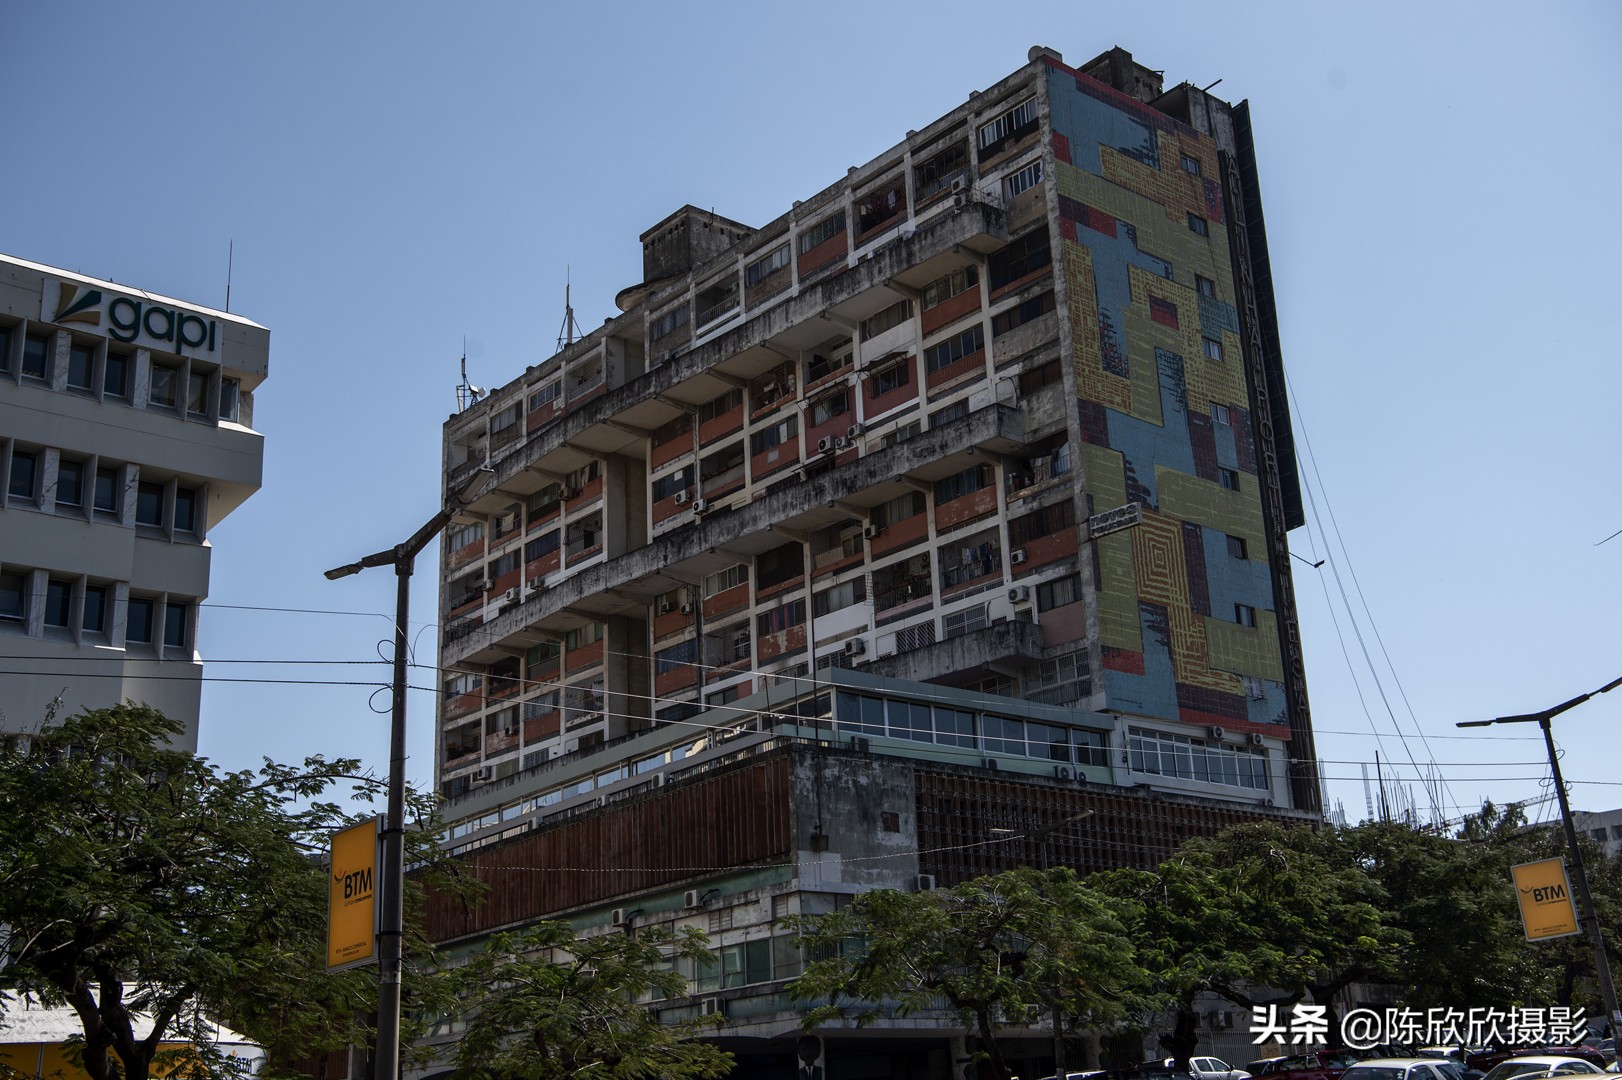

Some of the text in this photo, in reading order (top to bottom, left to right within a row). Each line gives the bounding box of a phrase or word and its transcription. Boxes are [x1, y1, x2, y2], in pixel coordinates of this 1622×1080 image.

[108, 298, 216, 355] gapi
[345, 867, 372, 898] BTM
[1533, 884, 1566, 902] BTM
